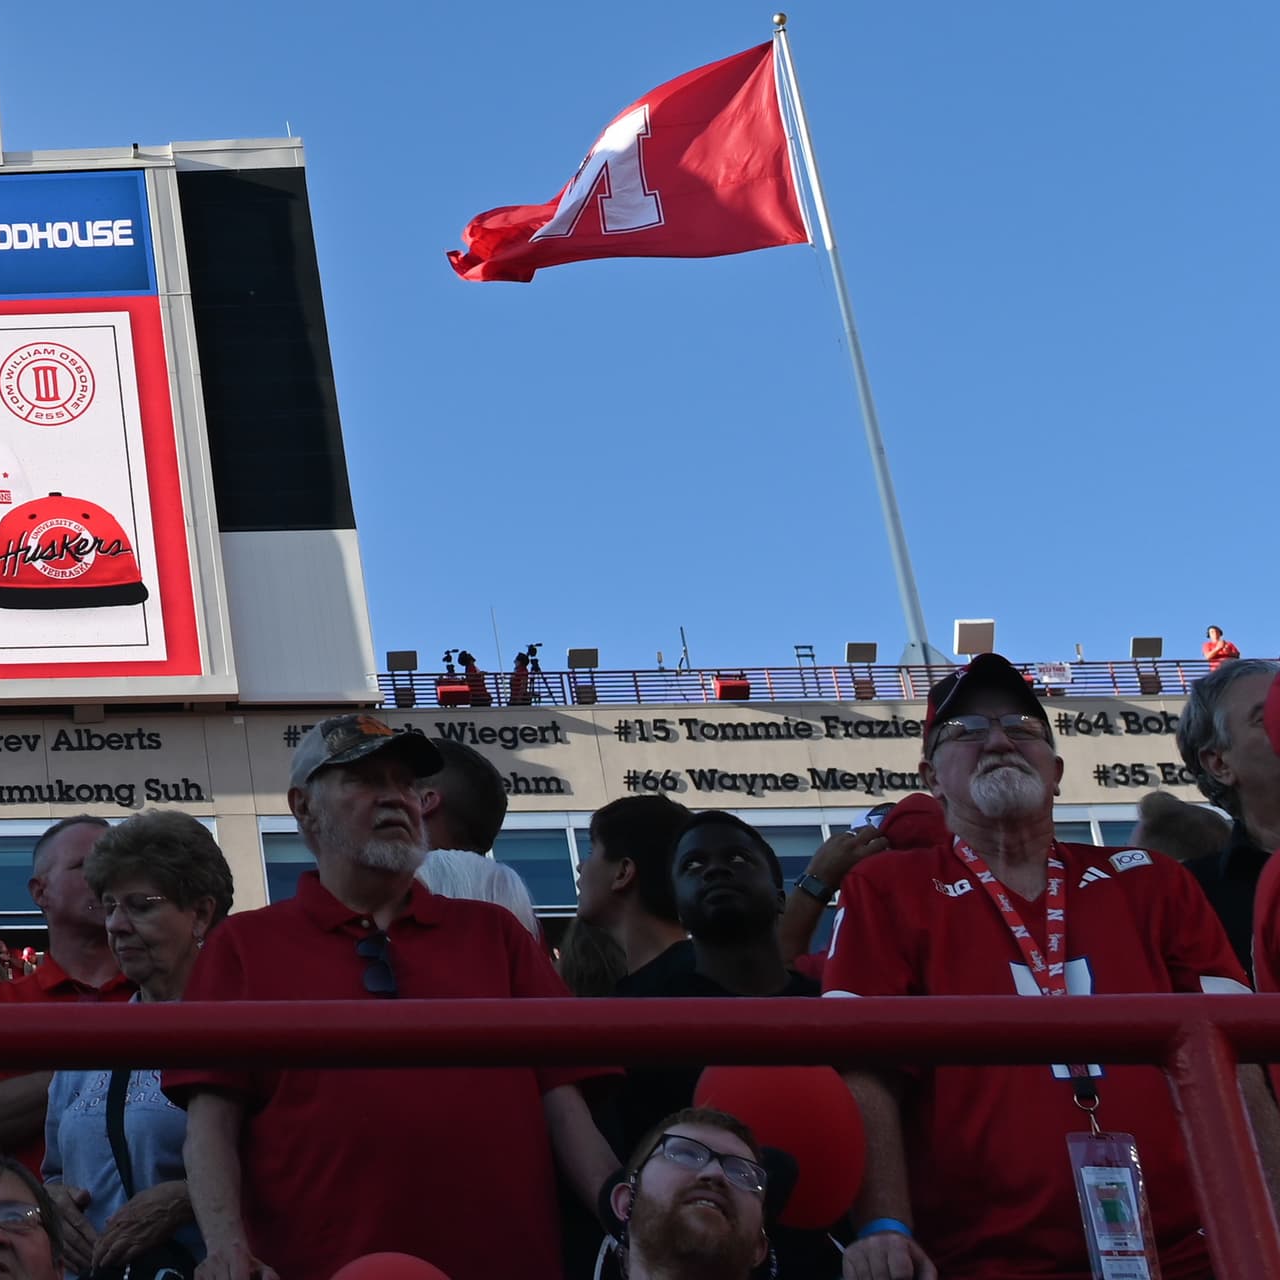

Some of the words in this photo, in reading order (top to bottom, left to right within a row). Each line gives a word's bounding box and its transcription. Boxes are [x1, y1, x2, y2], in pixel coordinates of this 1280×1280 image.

[5, 348, 56, 380] WILLIAM
[59, 352, 89, 410] OSBORNE
[5, 384, 25, 412] TOM
[34, 410, 65, 420] 255
[40, 560, 92, 579] NEBRASKA
[435, 721, 565, 750] Wiegert
[614, 718, 671, 742] #15
[679, 716, 813, 741] Tommie
[820, 715, 925, 739] Frazie
[1055, 712, 1114, 736] #64
[51, 728, 162, 752] Alberts
[501, 772, 565, 795] ehm
[623, 769, 679, 792] #66
[687, 768, 800, 795] Wayne
[1093, 762, 1150, 787] #35
[145, 777, 204, 802] Suh
